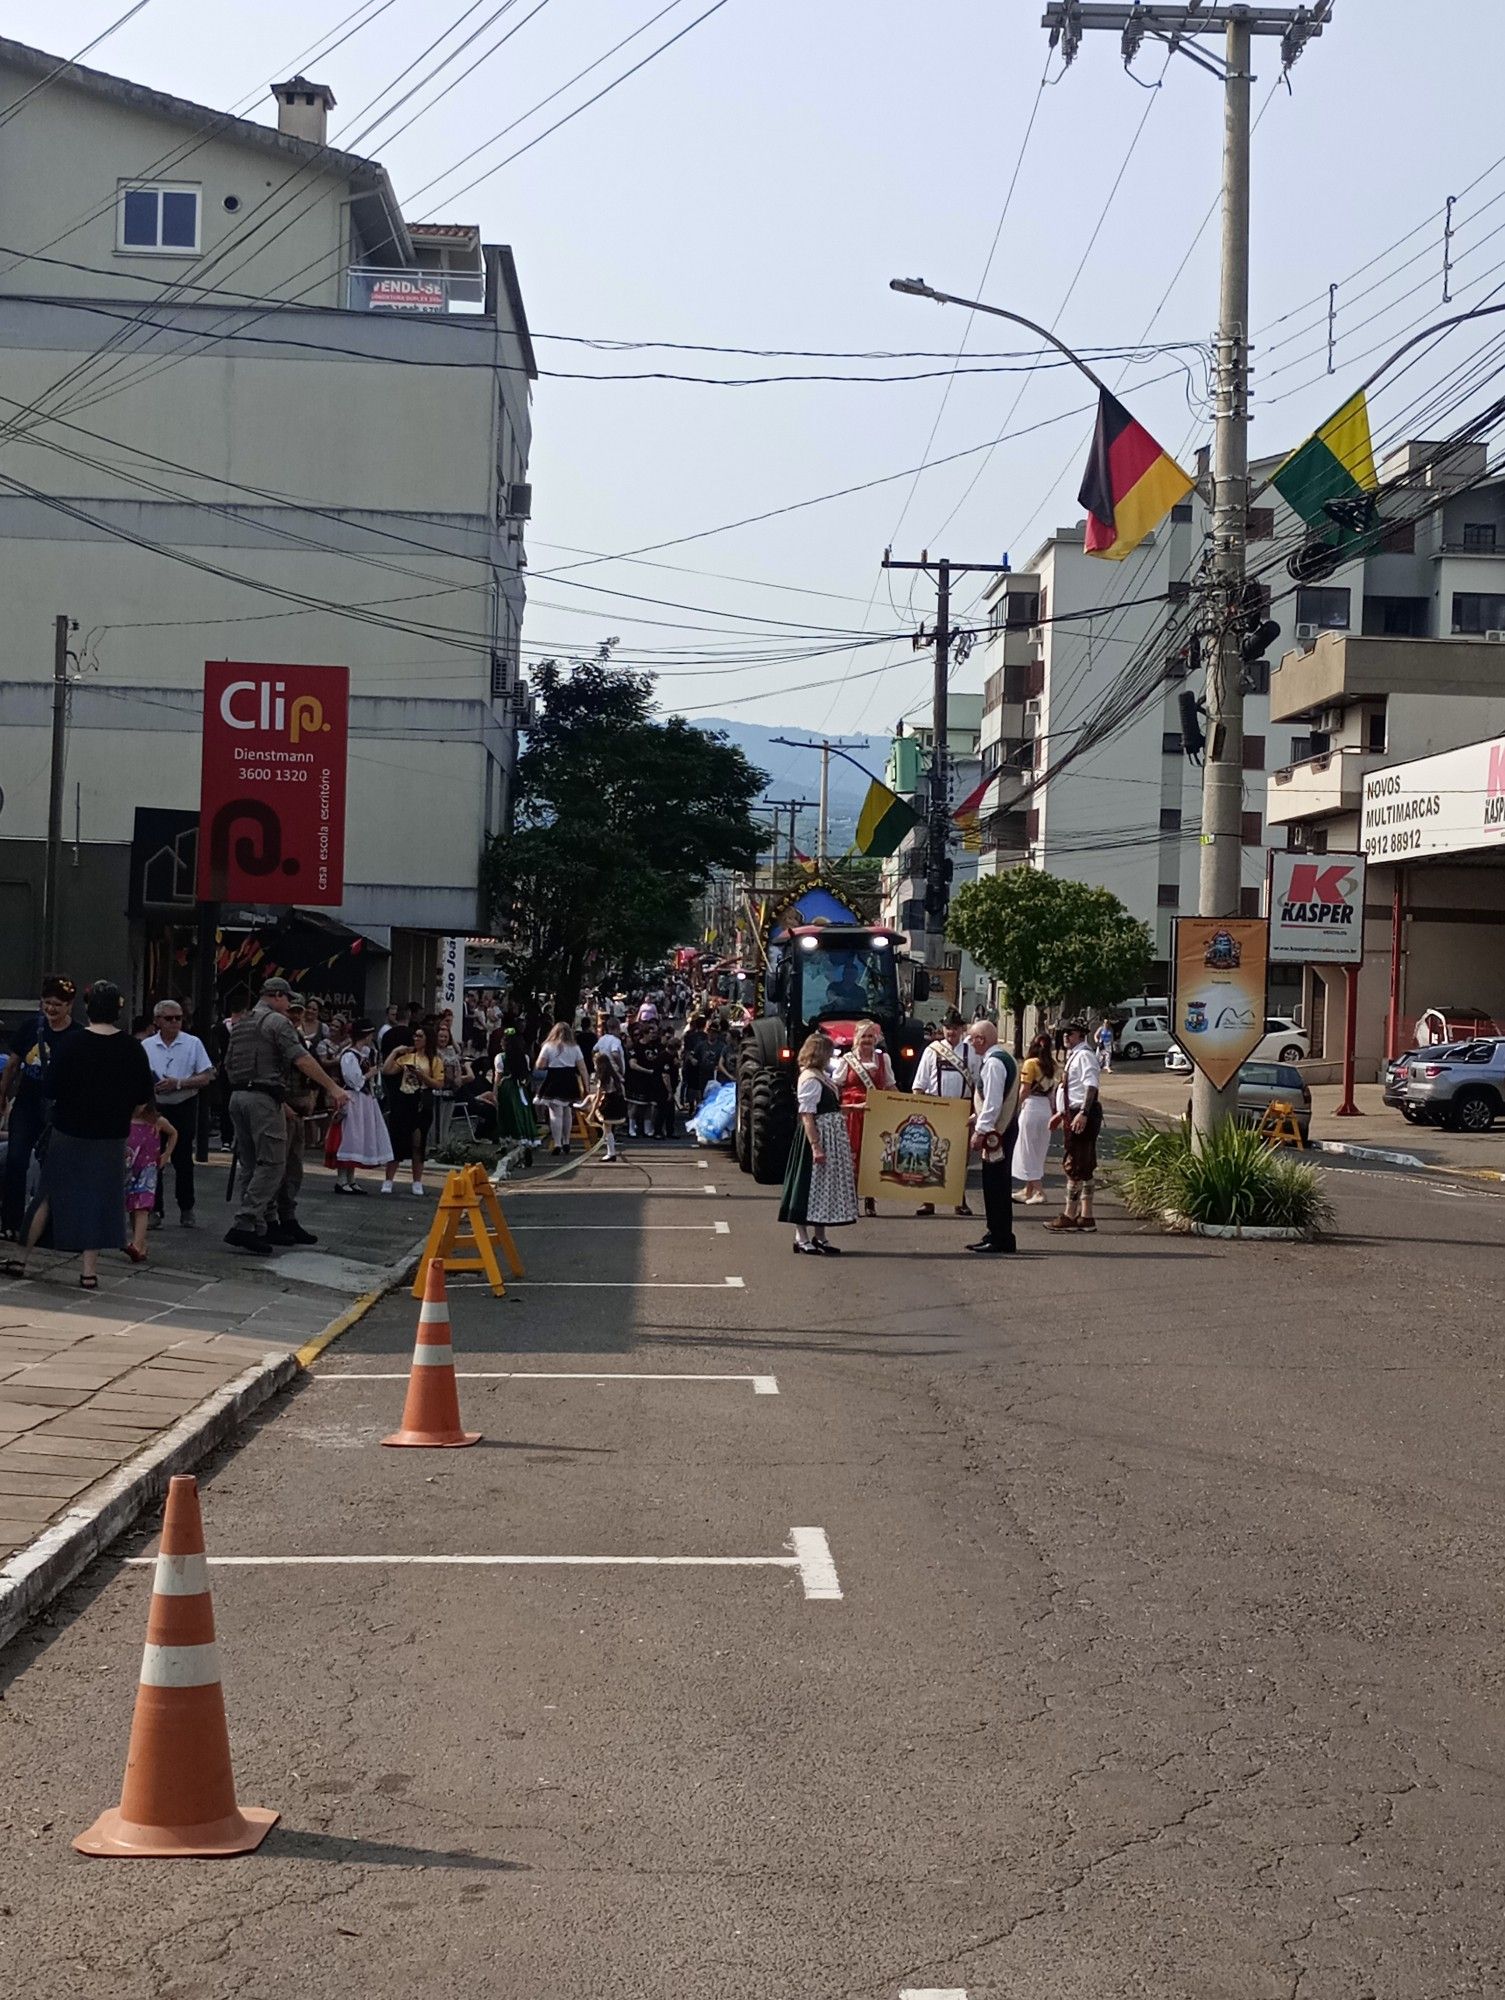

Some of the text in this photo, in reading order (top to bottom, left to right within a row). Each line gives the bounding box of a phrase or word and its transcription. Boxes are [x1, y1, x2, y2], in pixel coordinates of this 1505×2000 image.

[234, 747, 314, 762] Dienstmann
[239, 768, 308, 781] 3600 1320
[1367, 775, 1401, 800] NOVOS
[1366, 795, 1440, 828] MULTIMARCAS
[317, 768, 331, 891] casa escola escritório
[1365, 829, 1421, 856] 9912 88912
[1281, 902, 1354, 924] KASPER
[445, 937, 457, 1003] São Joã
